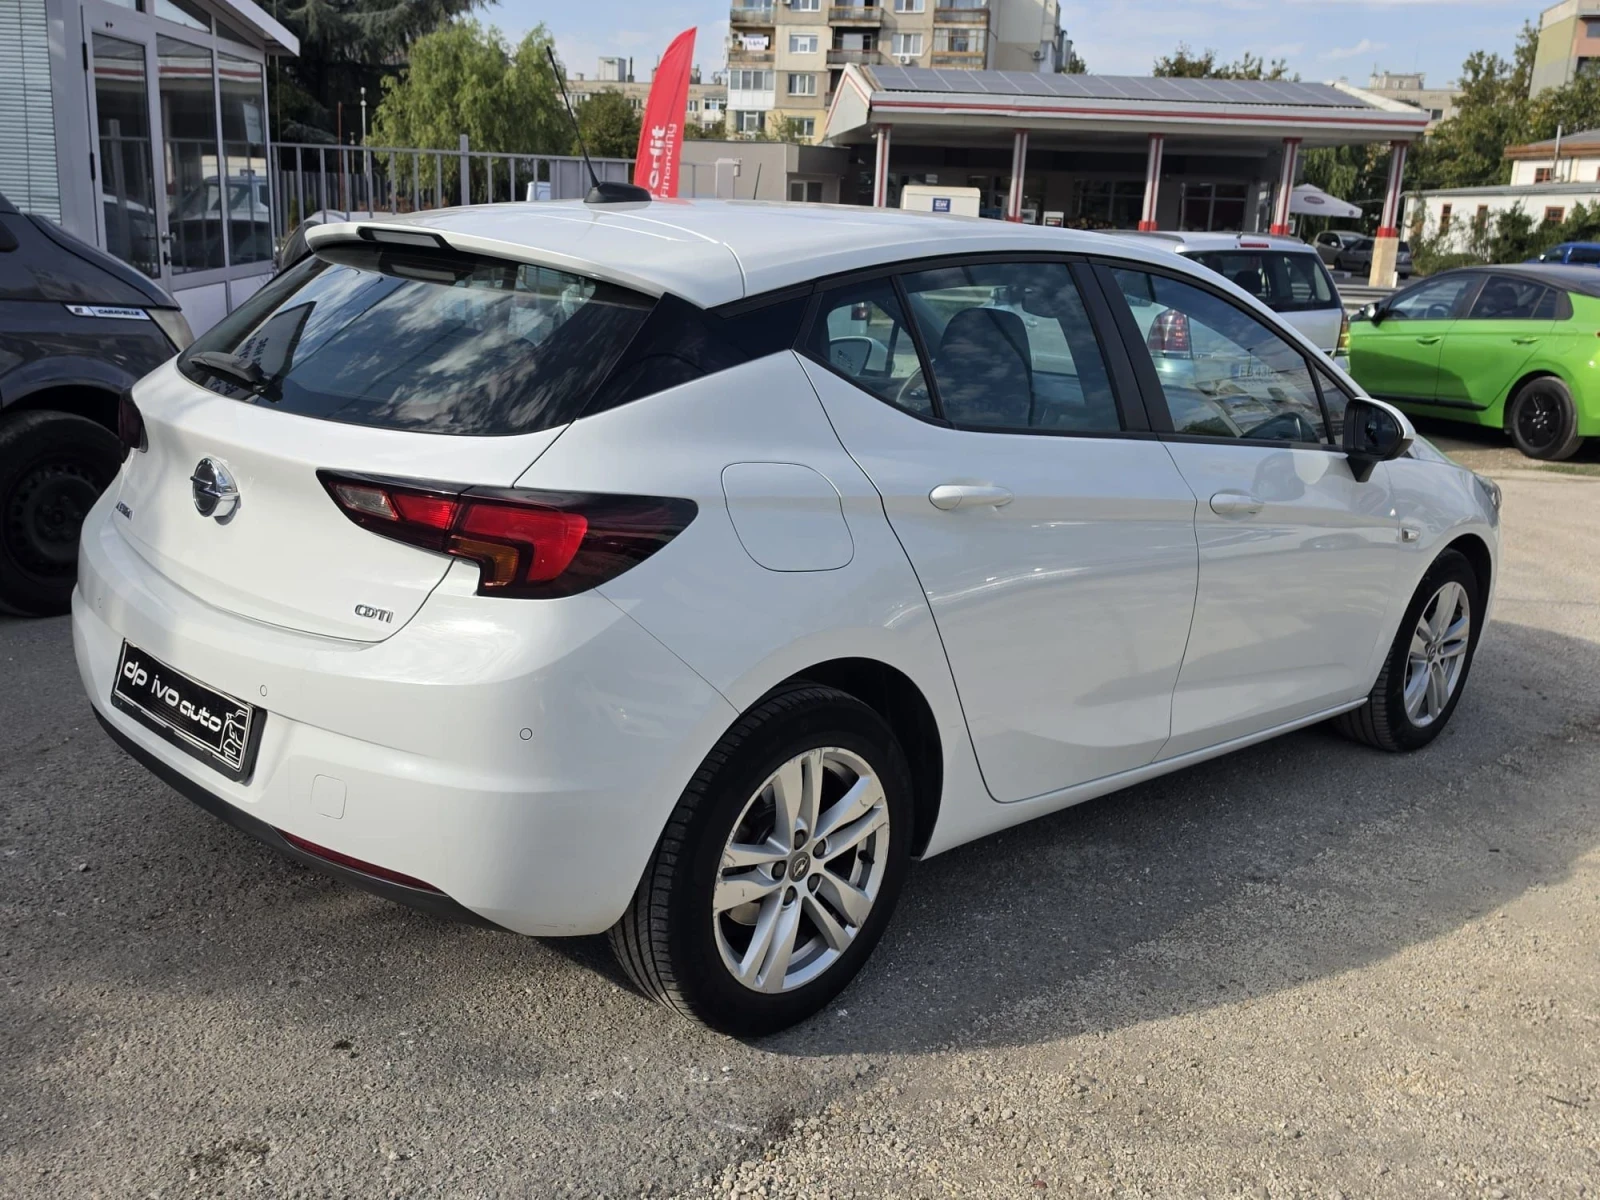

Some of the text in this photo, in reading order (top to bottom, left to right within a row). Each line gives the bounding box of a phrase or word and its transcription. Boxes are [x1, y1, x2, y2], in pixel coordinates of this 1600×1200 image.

[660, 123, 677, 198] Financing
[123, 661, 222, 732] dp ivo auto
